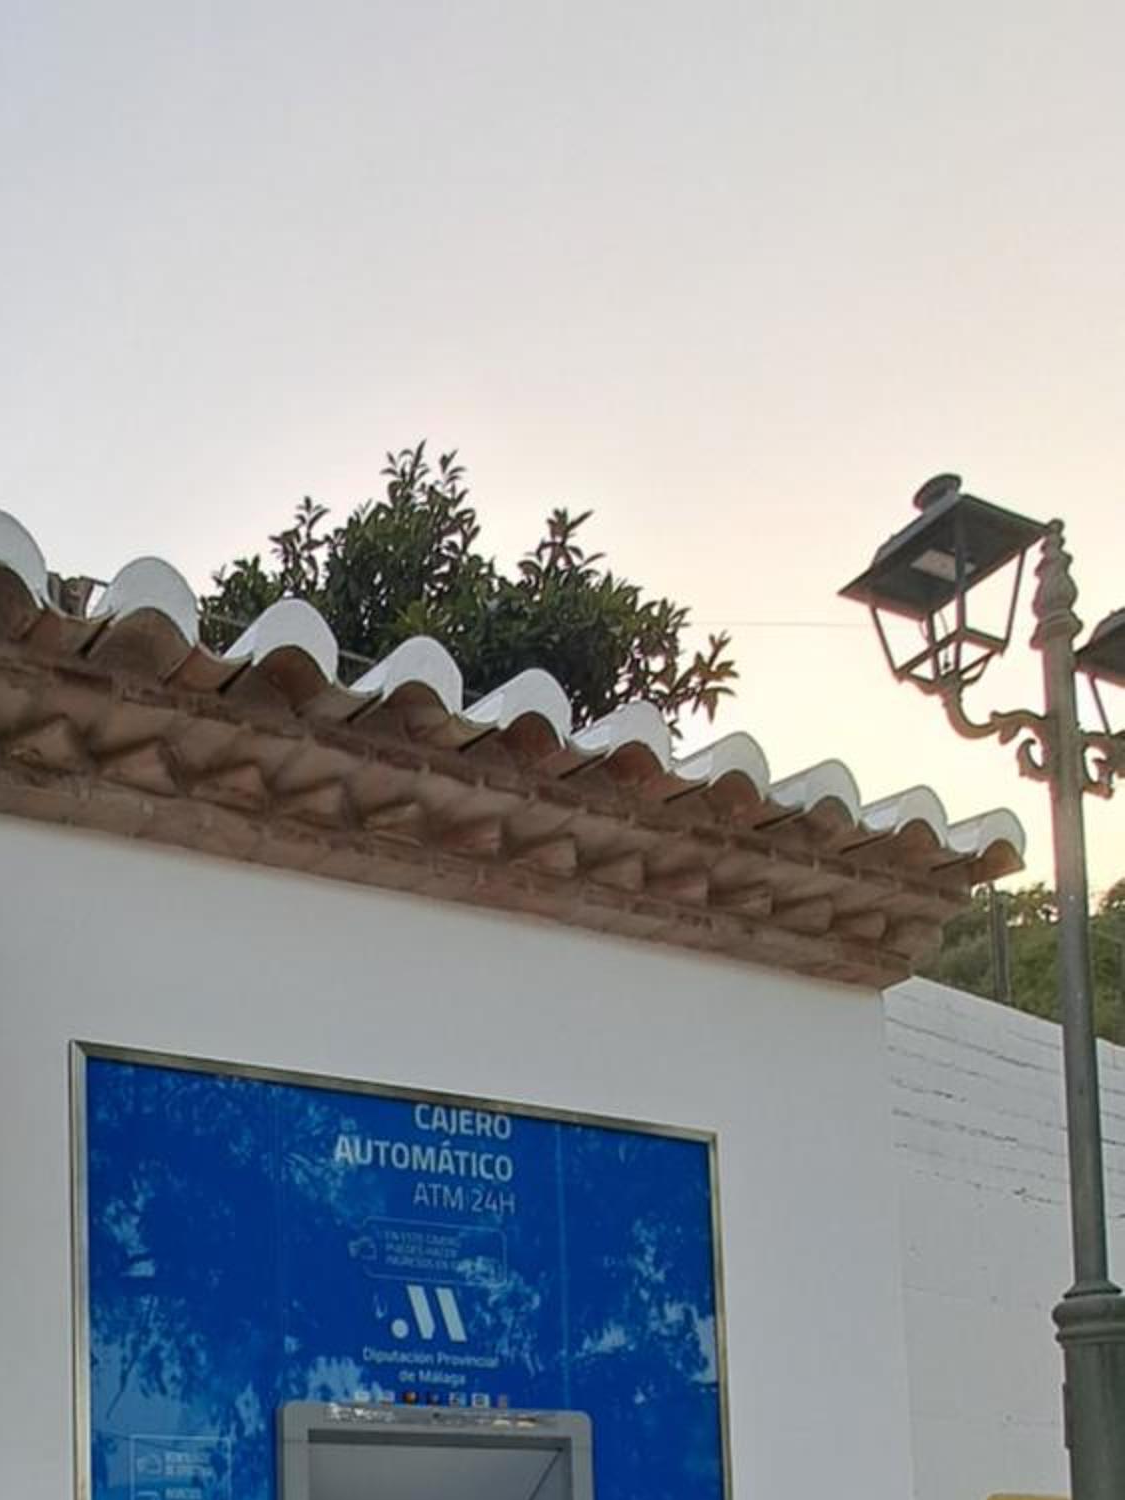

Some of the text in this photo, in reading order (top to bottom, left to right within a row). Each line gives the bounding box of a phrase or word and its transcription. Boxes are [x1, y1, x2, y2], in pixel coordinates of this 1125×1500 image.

[414, 1103, 512, 1140] CAJERO
[334, 1133, 514, 1182] AUTOMÁTICO
[413, 1182, 515, 1215] ATM 24H
[362, 1347, 500, 1368] Diputación Provincial
[399, 1370, 416, 1383] de
